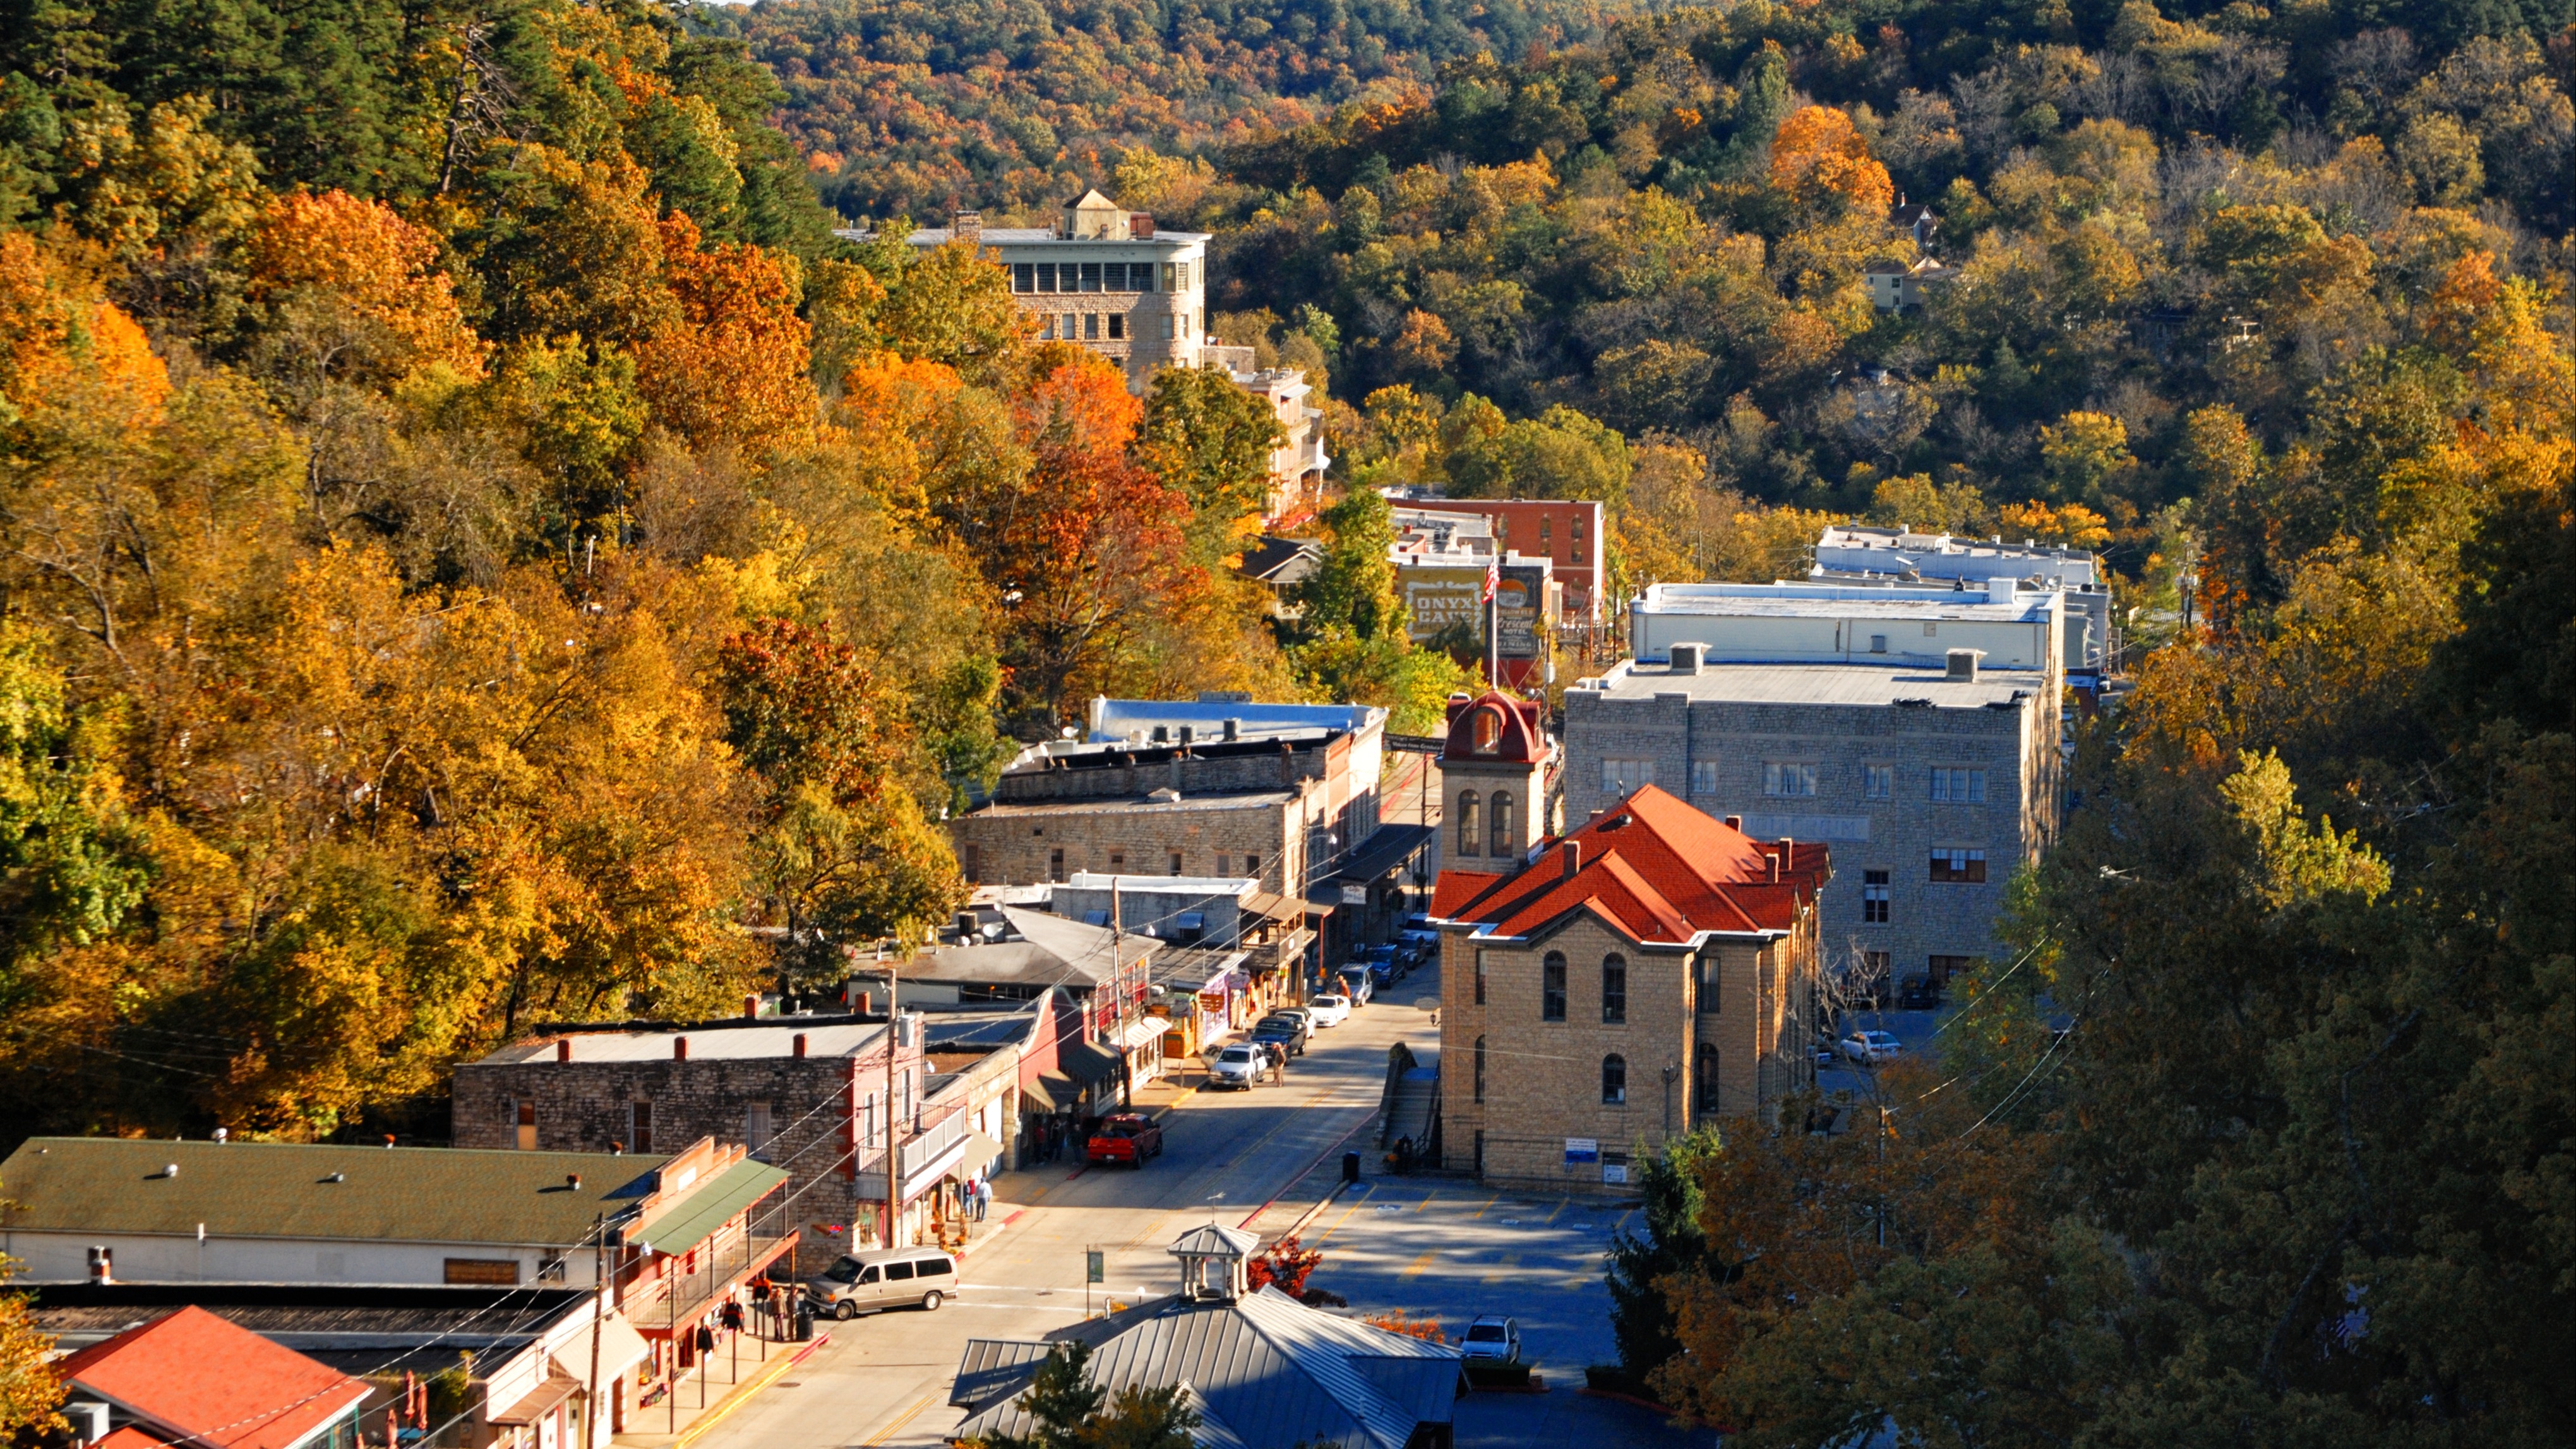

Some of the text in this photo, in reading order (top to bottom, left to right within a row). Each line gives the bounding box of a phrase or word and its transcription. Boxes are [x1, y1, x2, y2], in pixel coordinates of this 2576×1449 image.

[1417, 598, 1473, 609] ONYX
[1418, 611, 1472, 623] CAVE
[1498, 617, 1533, 628] Crescent
